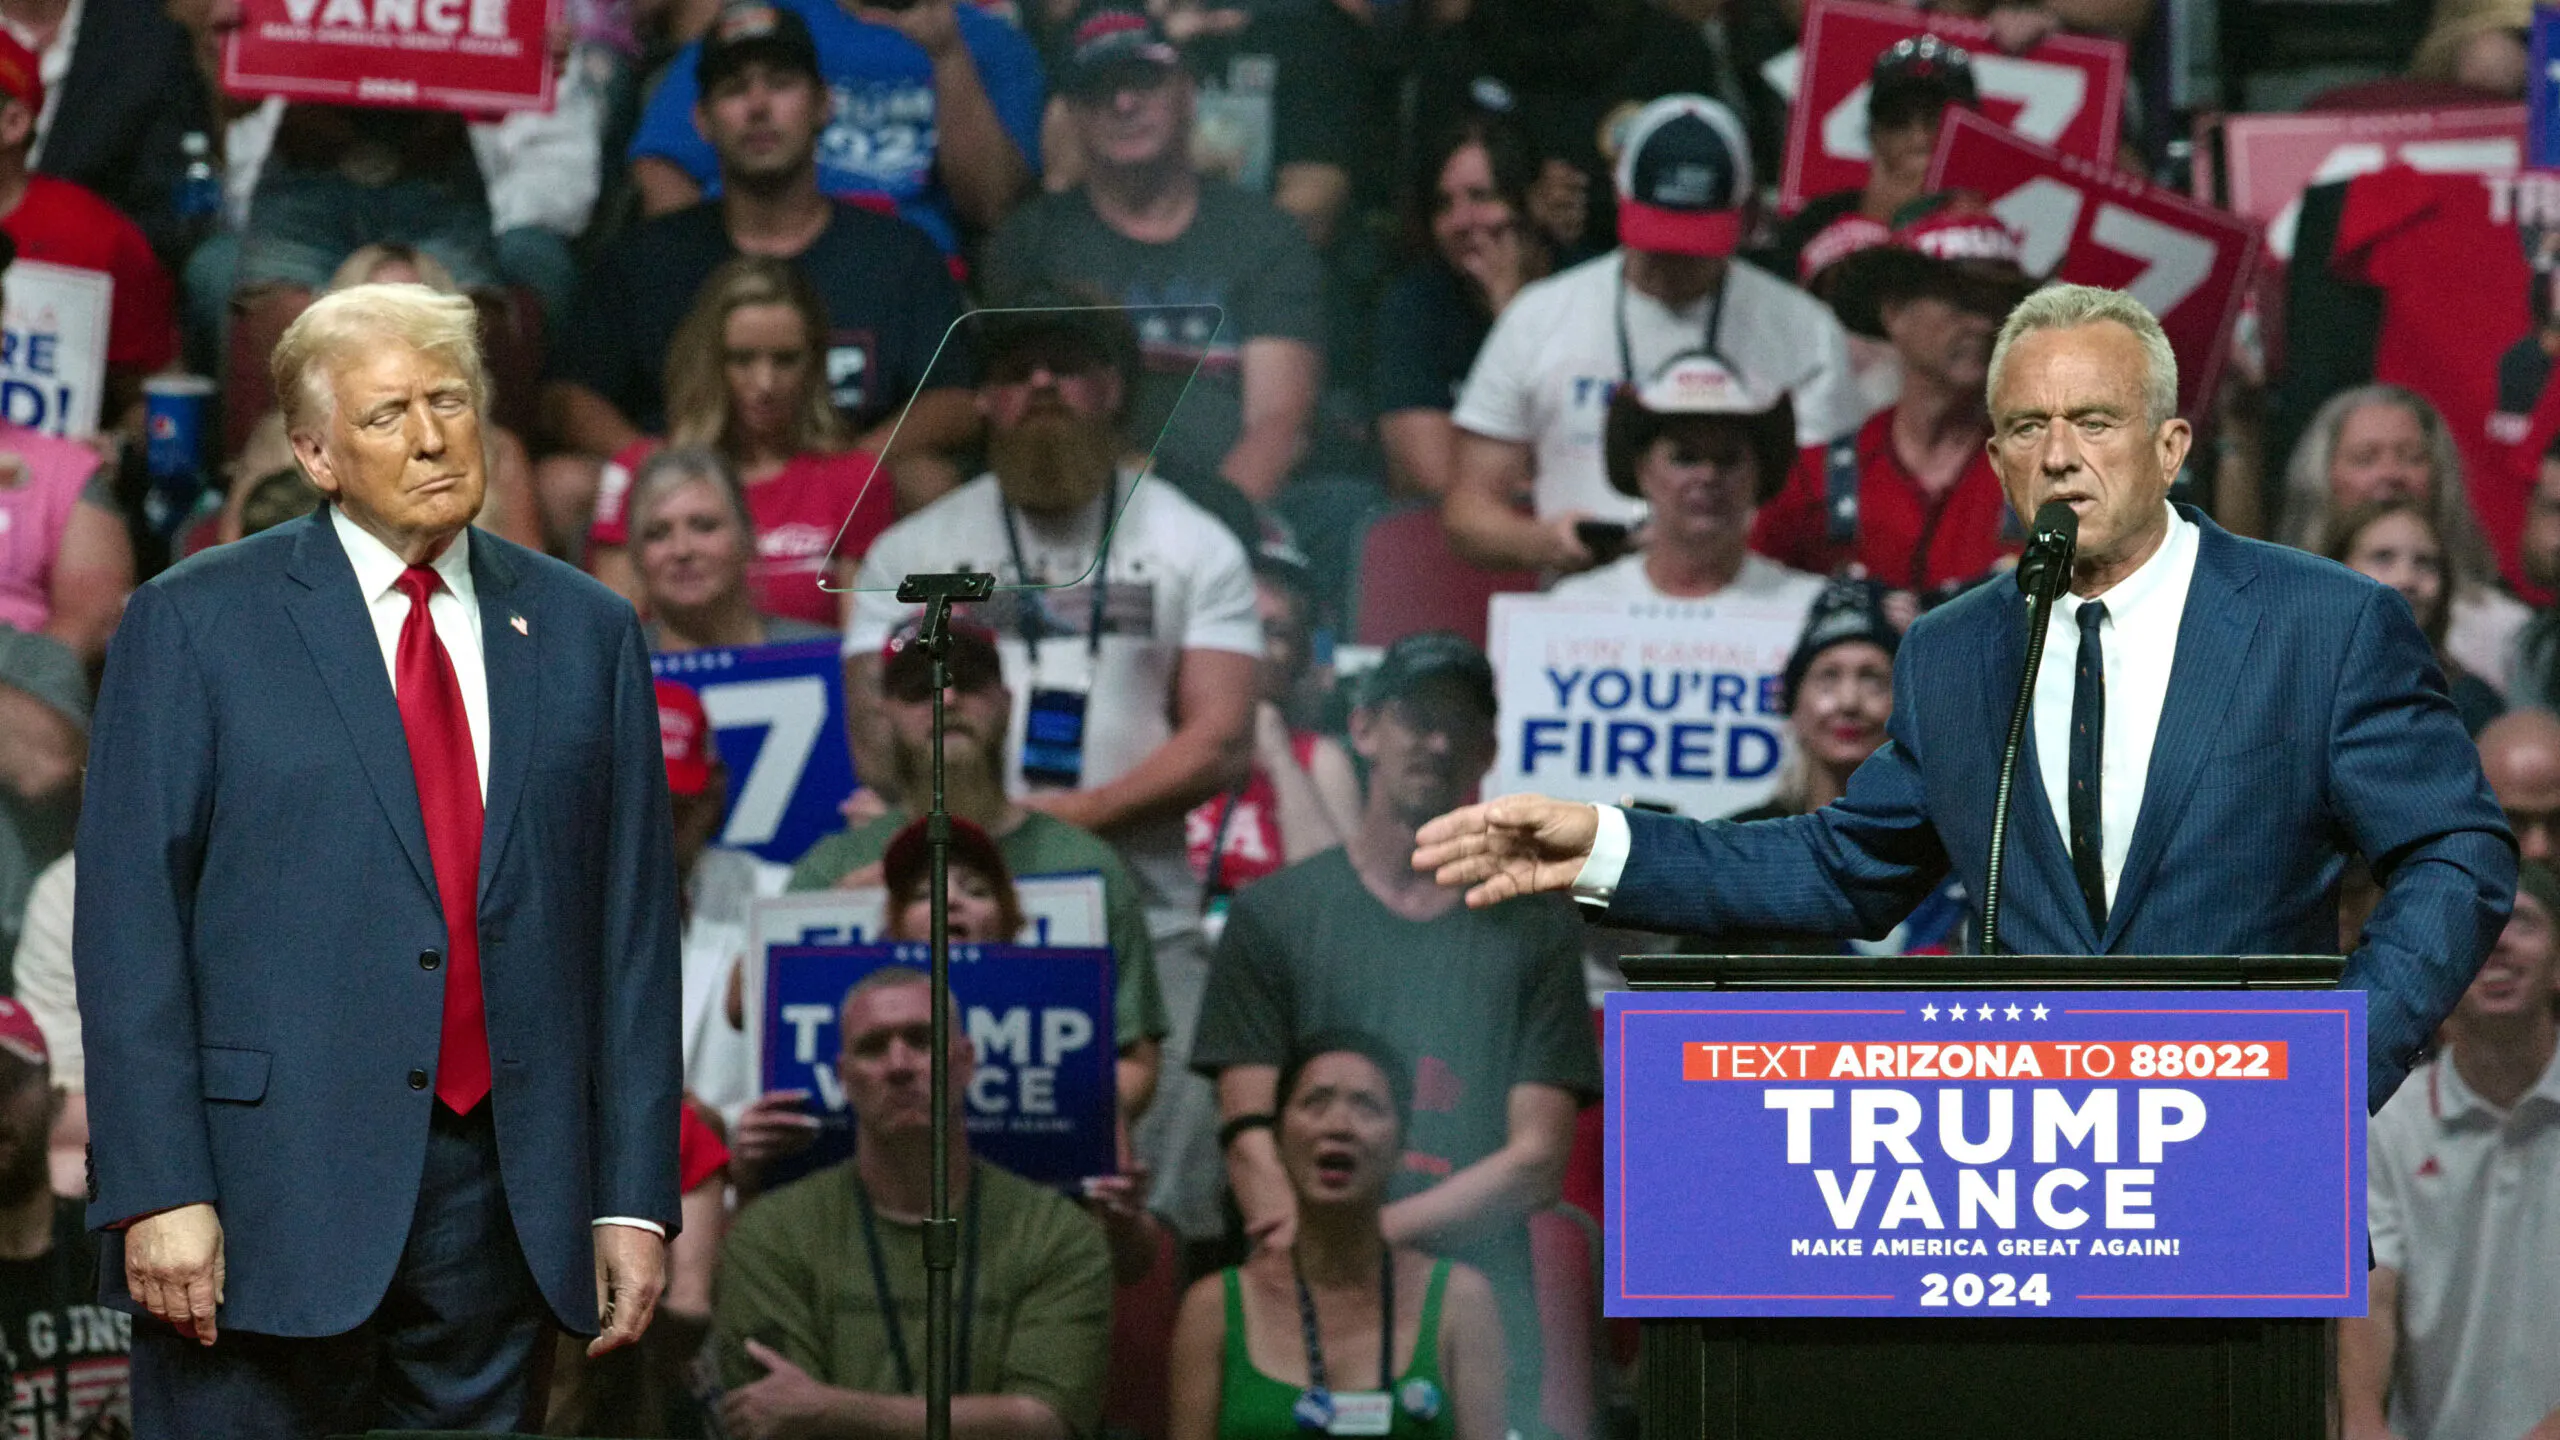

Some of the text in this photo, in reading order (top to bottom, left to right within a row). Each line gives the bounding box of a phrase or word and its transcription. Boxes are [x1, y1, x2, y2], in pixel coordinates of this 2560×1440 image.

[282, 0, 508, 38] VANCE
[1546, 667, 1786, 715] YOU'RE
[781, 1004, 1094, 1065] TMP
[1702, 1044, 2270, 1078] TEXT ARIZONA TO 88022
[813, 1064, 1058, 1115] VCE
[1764, 1088, 2208, 1165] TRUMP
[1813, 1168, 2156, 1230] VANCE
[1791, 1239, 2181, 1256] MAKE AMERICA GREAT AGAIN!
[1920, 1272, 2051, 1307] 2024
